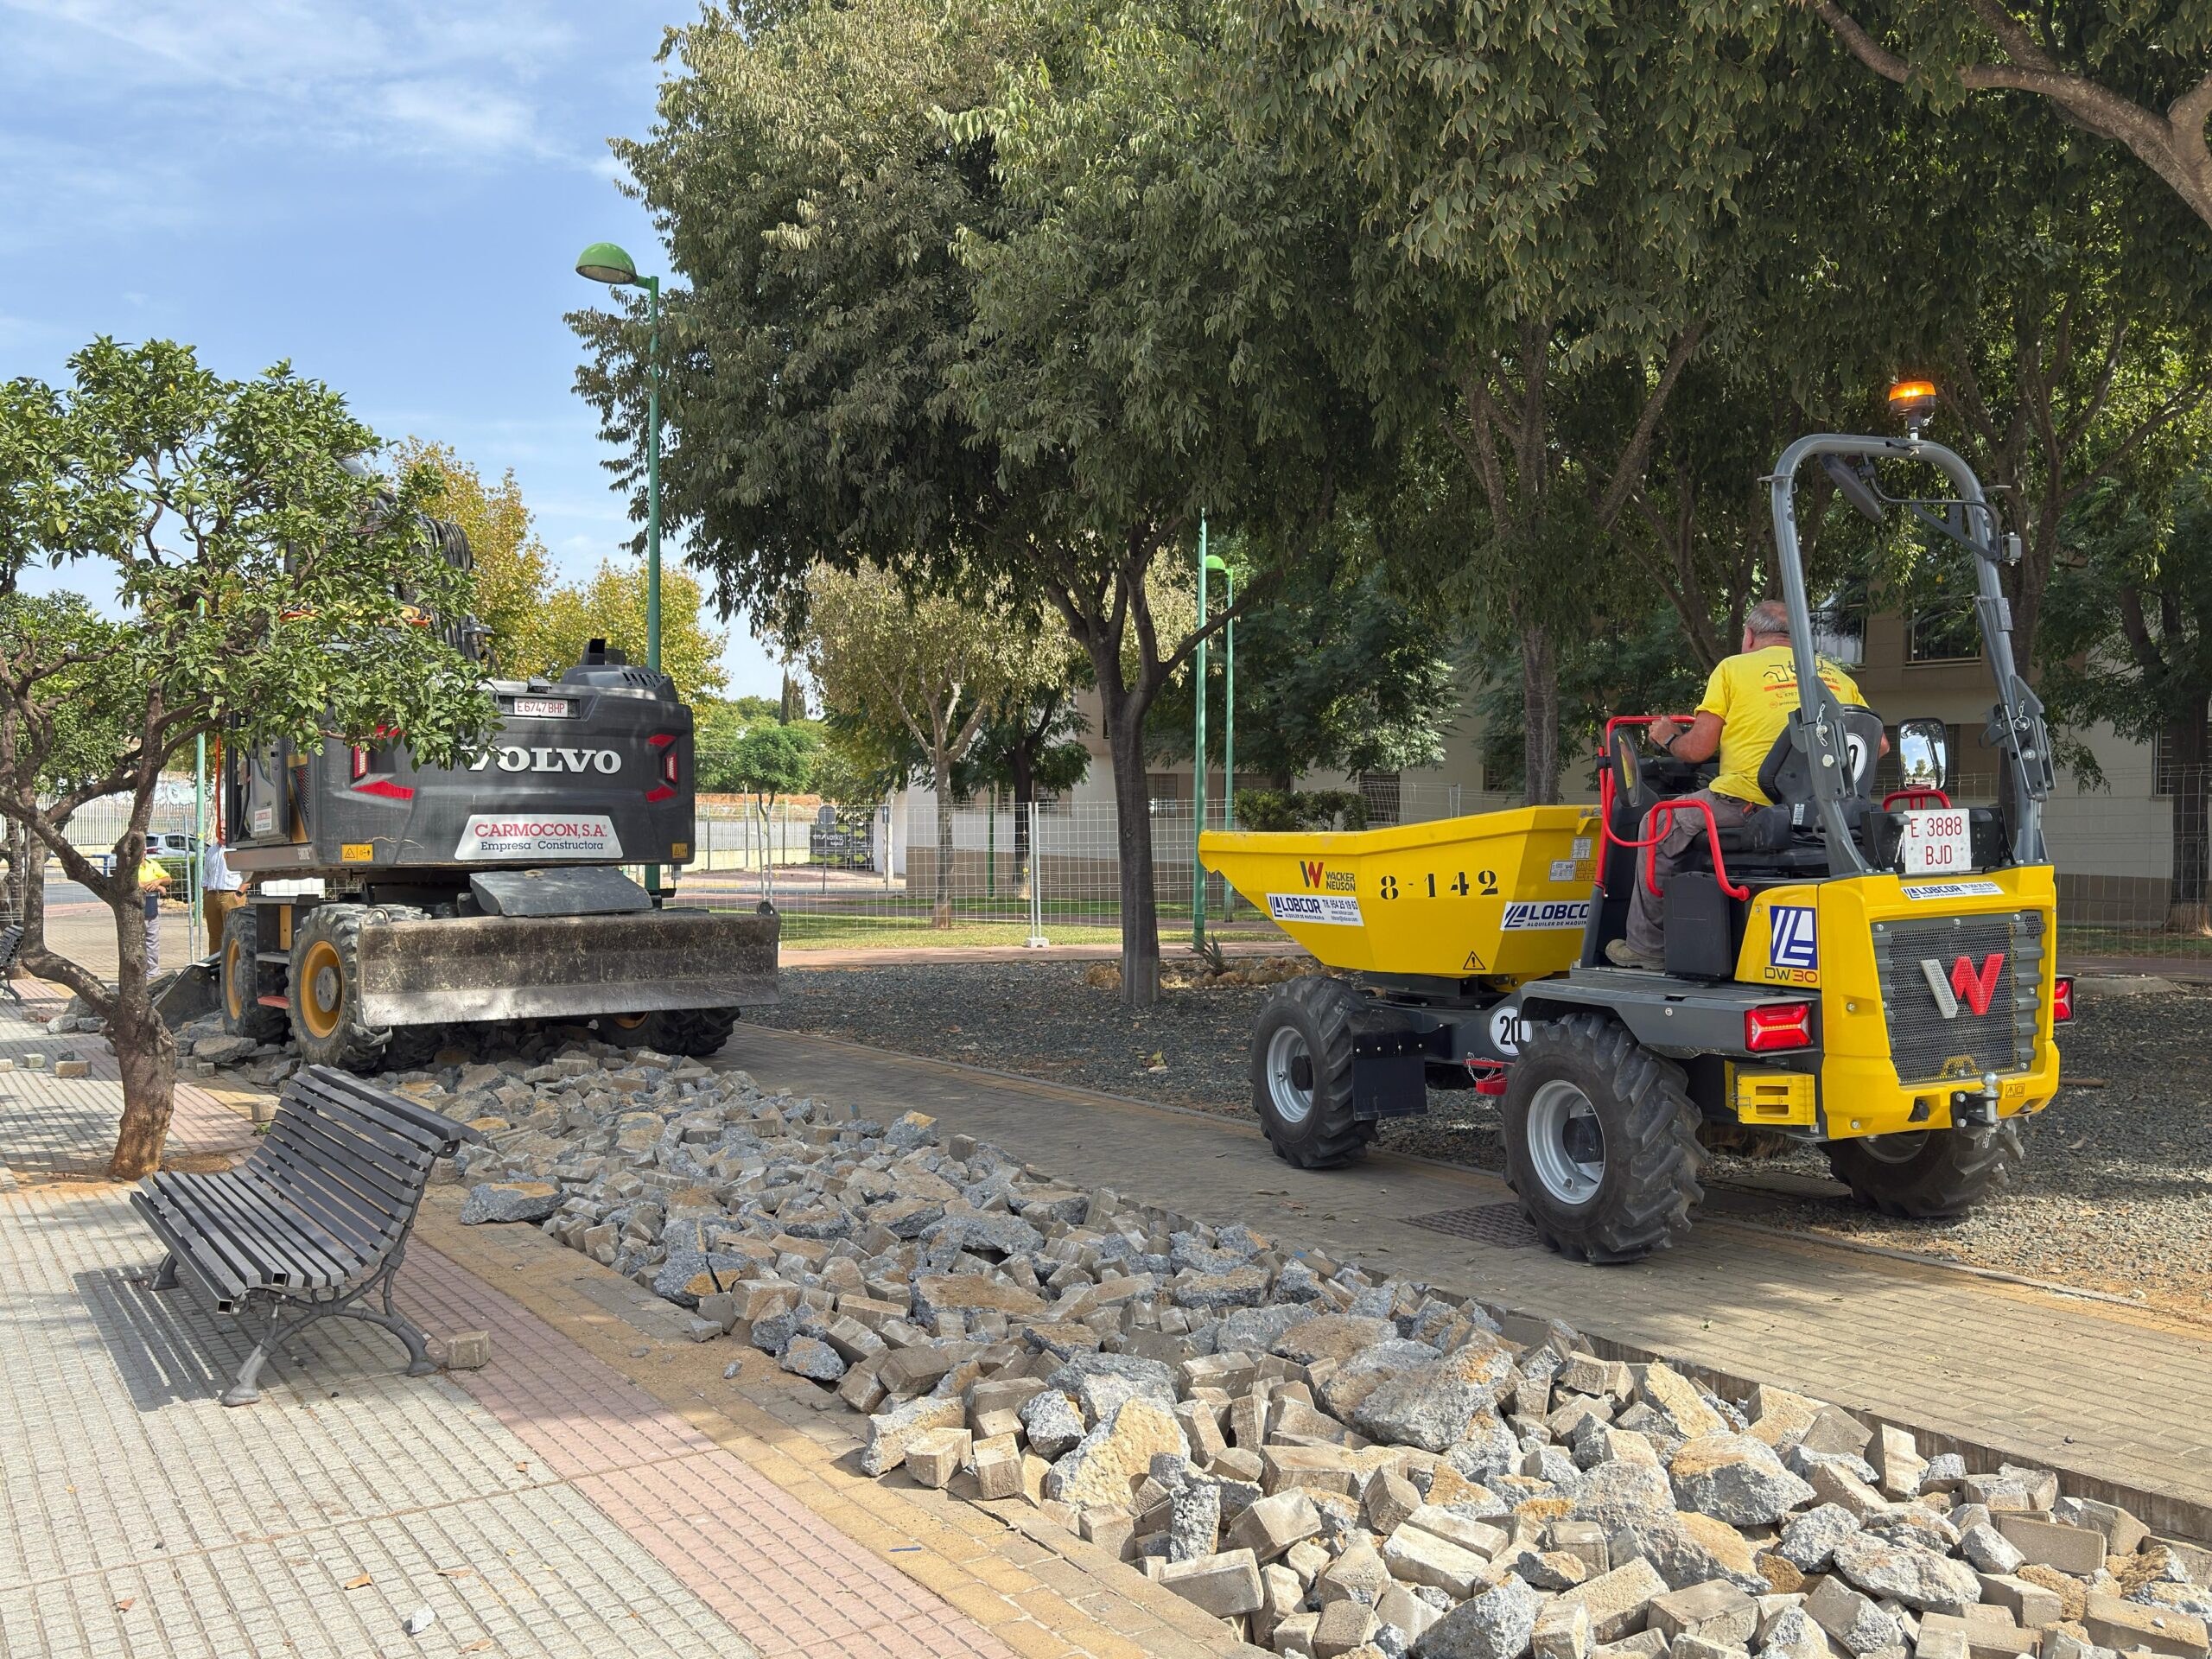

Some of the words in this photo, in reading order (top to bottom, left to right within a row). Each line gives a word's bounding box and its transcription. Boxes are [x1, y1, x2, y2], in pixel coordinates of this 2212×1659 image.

[517, 701, 523, 712] E
[524, 701, 546, 713] 6747
[548, 702, 565, 714] BHP
[460, 745, 622, 774] VOLVO
[1910, 818, 1919, 837] E
[1927, 816, 1962, 837] 3888
[480, 841, 531, 852] Empresa
[537, 840, 604, 850] Constructora
[1926, 844, 1952, 865] BJD
[1325, 870, 1356, 882] WACKER
[1325, 880, 1356, 892] NEUSON
[1916, 885, 1962, 894] LOBCOR
[1280, 896, 1322, 914] LOBCOR
[1764, 967, 1818, 983] DW30
[1500, 1015, 1522, 1046] 20
